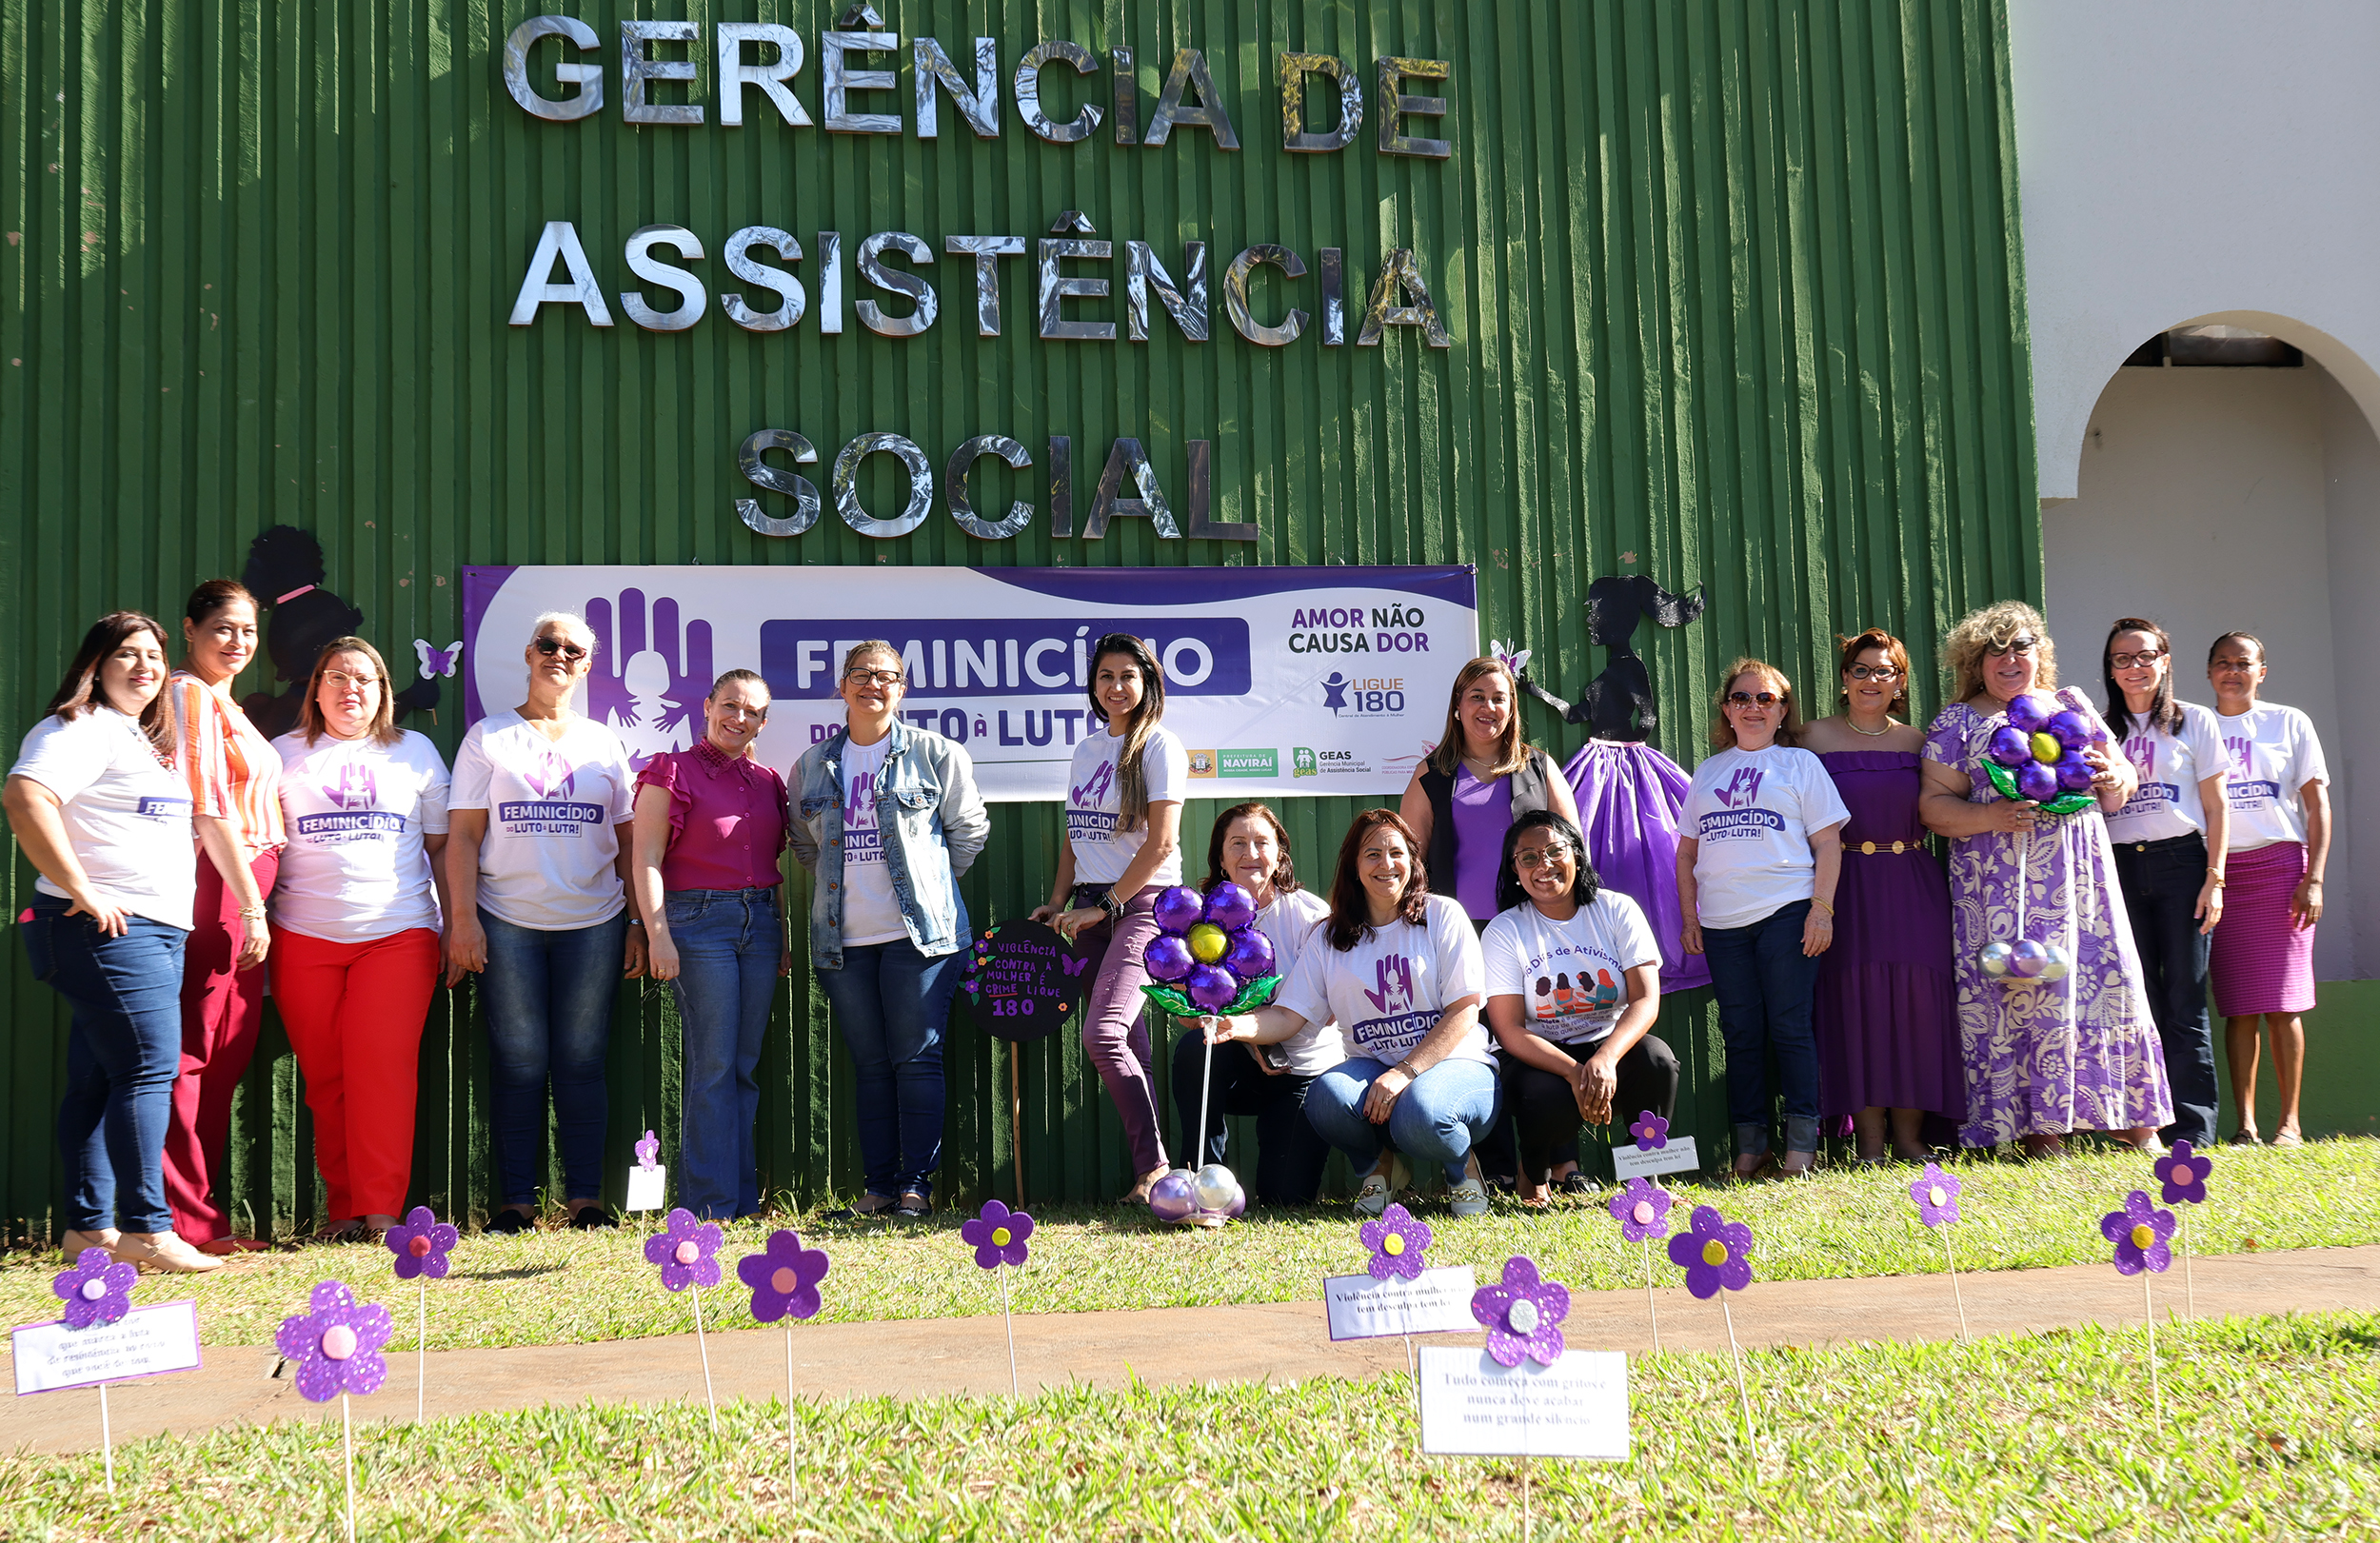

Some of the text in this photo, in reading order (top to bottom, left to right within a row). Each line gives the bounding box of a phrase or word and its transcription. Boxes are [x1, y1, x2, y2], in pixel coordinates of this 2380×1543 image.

[503, 3, 1452, 160] GERÊNCIA DE
[507, 210, 1451, 348] ASSISTÊNCIA
[735, 428, 1259, 542] SOCIAL
[1292, 603, 1424, 628] AMOR NÃO
[1288, 632, 1430, 653] CAUSA DOR
[1353, 678, 1403, 690] LIGUE
[1354, 691, 1405, 712] 180
[974, 713, 988, 737] À
[1222, 756, 1273, 768] NAVIRAÍ
[1319, 750, 1352, 761] GEAS
[1293, 767, 1318, 778] geas
[504, 803, 597, 821] FEMINICÍDIO
[302, 813, 401, 832] FEMINICÍDIO
[514, 822, 543, 833] LUTO
[548, 823, 580, 834] LUTA!
[1731, 828, 1761, 838] LUTA!
[1555, 946, 1571, 957] de
[995, 959, 1052, 973] CONTRA A
[986, 970, 1046, 985] MULHER É
[985, 983, 1018, 995] CRIME
[992, 999, 1035, 1017] 180
[1618, 1151, 1642, 1161] Violência
[1643, 1150, 1660, 1158] contra
[1336, 1291, 1380, 1303] Violência
[1382, 1289, 1413, 1298] contra
[1357, 1304, 1376, 1314] tem
[1420, 1300, 1438, 1309] tem
[1444, 1373, 1478, 1386] Tudo
[1481, 1375, 1528, 1390] começa
[1532, 1377, 1559, 1389] com
[1467, 1395, 1506, 1406] nunca
[1510, 1393, 1539, 1406] deve
[1463, 1414, 1493, 1424] num
[1497, 1413, 1541, 1427] grande
